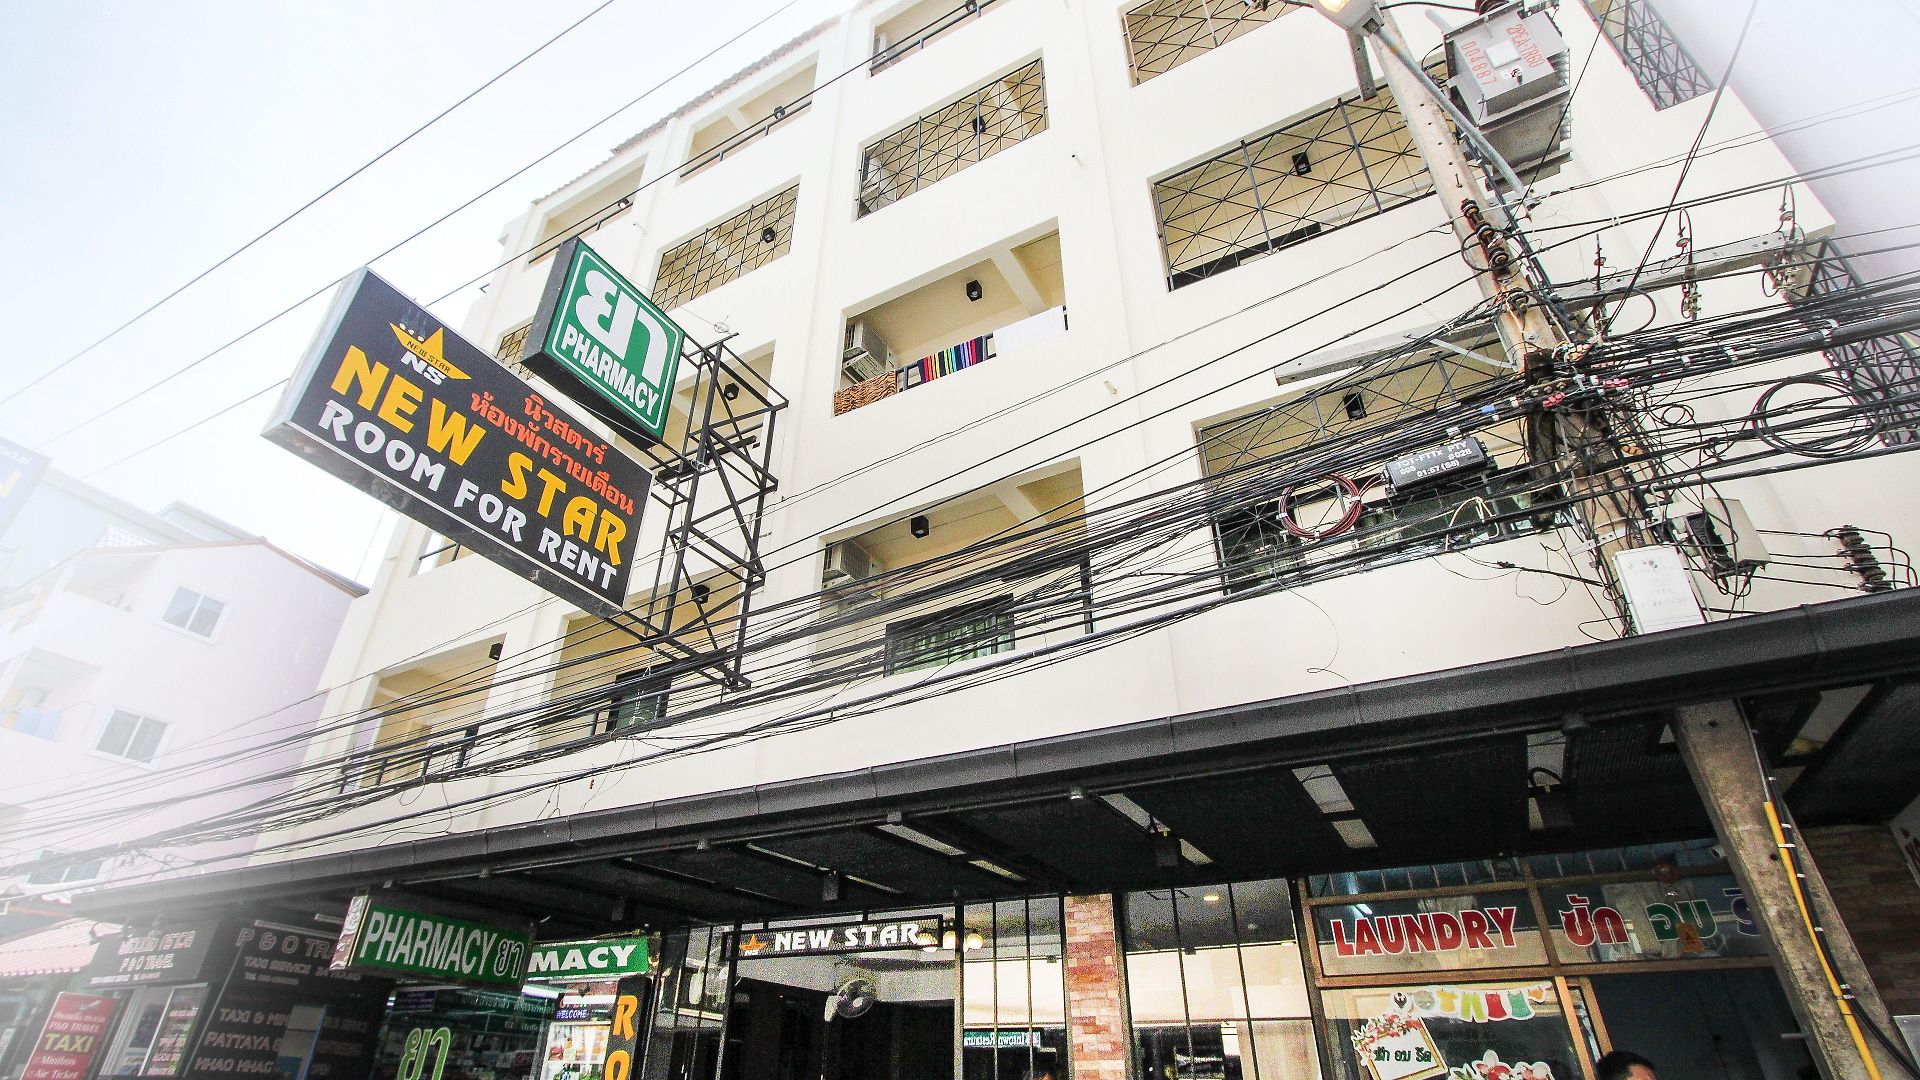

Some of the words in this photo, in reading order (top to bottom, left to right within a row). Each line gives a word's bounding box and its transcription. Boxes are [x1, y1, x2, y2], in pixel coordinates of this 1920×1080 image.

[406, 341, 428, 358] NEW
[427, 354, 451, 373] STAR
[575, 269, 668, 386] ยา
[400, 350, 447, 386] NS
[560, 331, 659, 416] PHARMACY
[330, 344, 487, 467] NEW
[501, 451, 629, 567] STAR
[470, 391, 635, 516] ห้องพักรายเดือน
[524, 393, 608, 465] นิวสตาร์
[318, 399, 446, 493] ROOM
[453, 476, 529, 544] FOR
[537, 525, 618, 592] RENT
[281, 935, 300, 954] O
[359, 911, 498, 976] PHARMACY
[494, 938, 525, 978] ยา
[774, 931, 833, 951] NEW
[844, 923, 921, 947] STAR
[1330, 906, 1518, 957] LAUNDRY
[44, 1033, 95, 1053] TAXI
